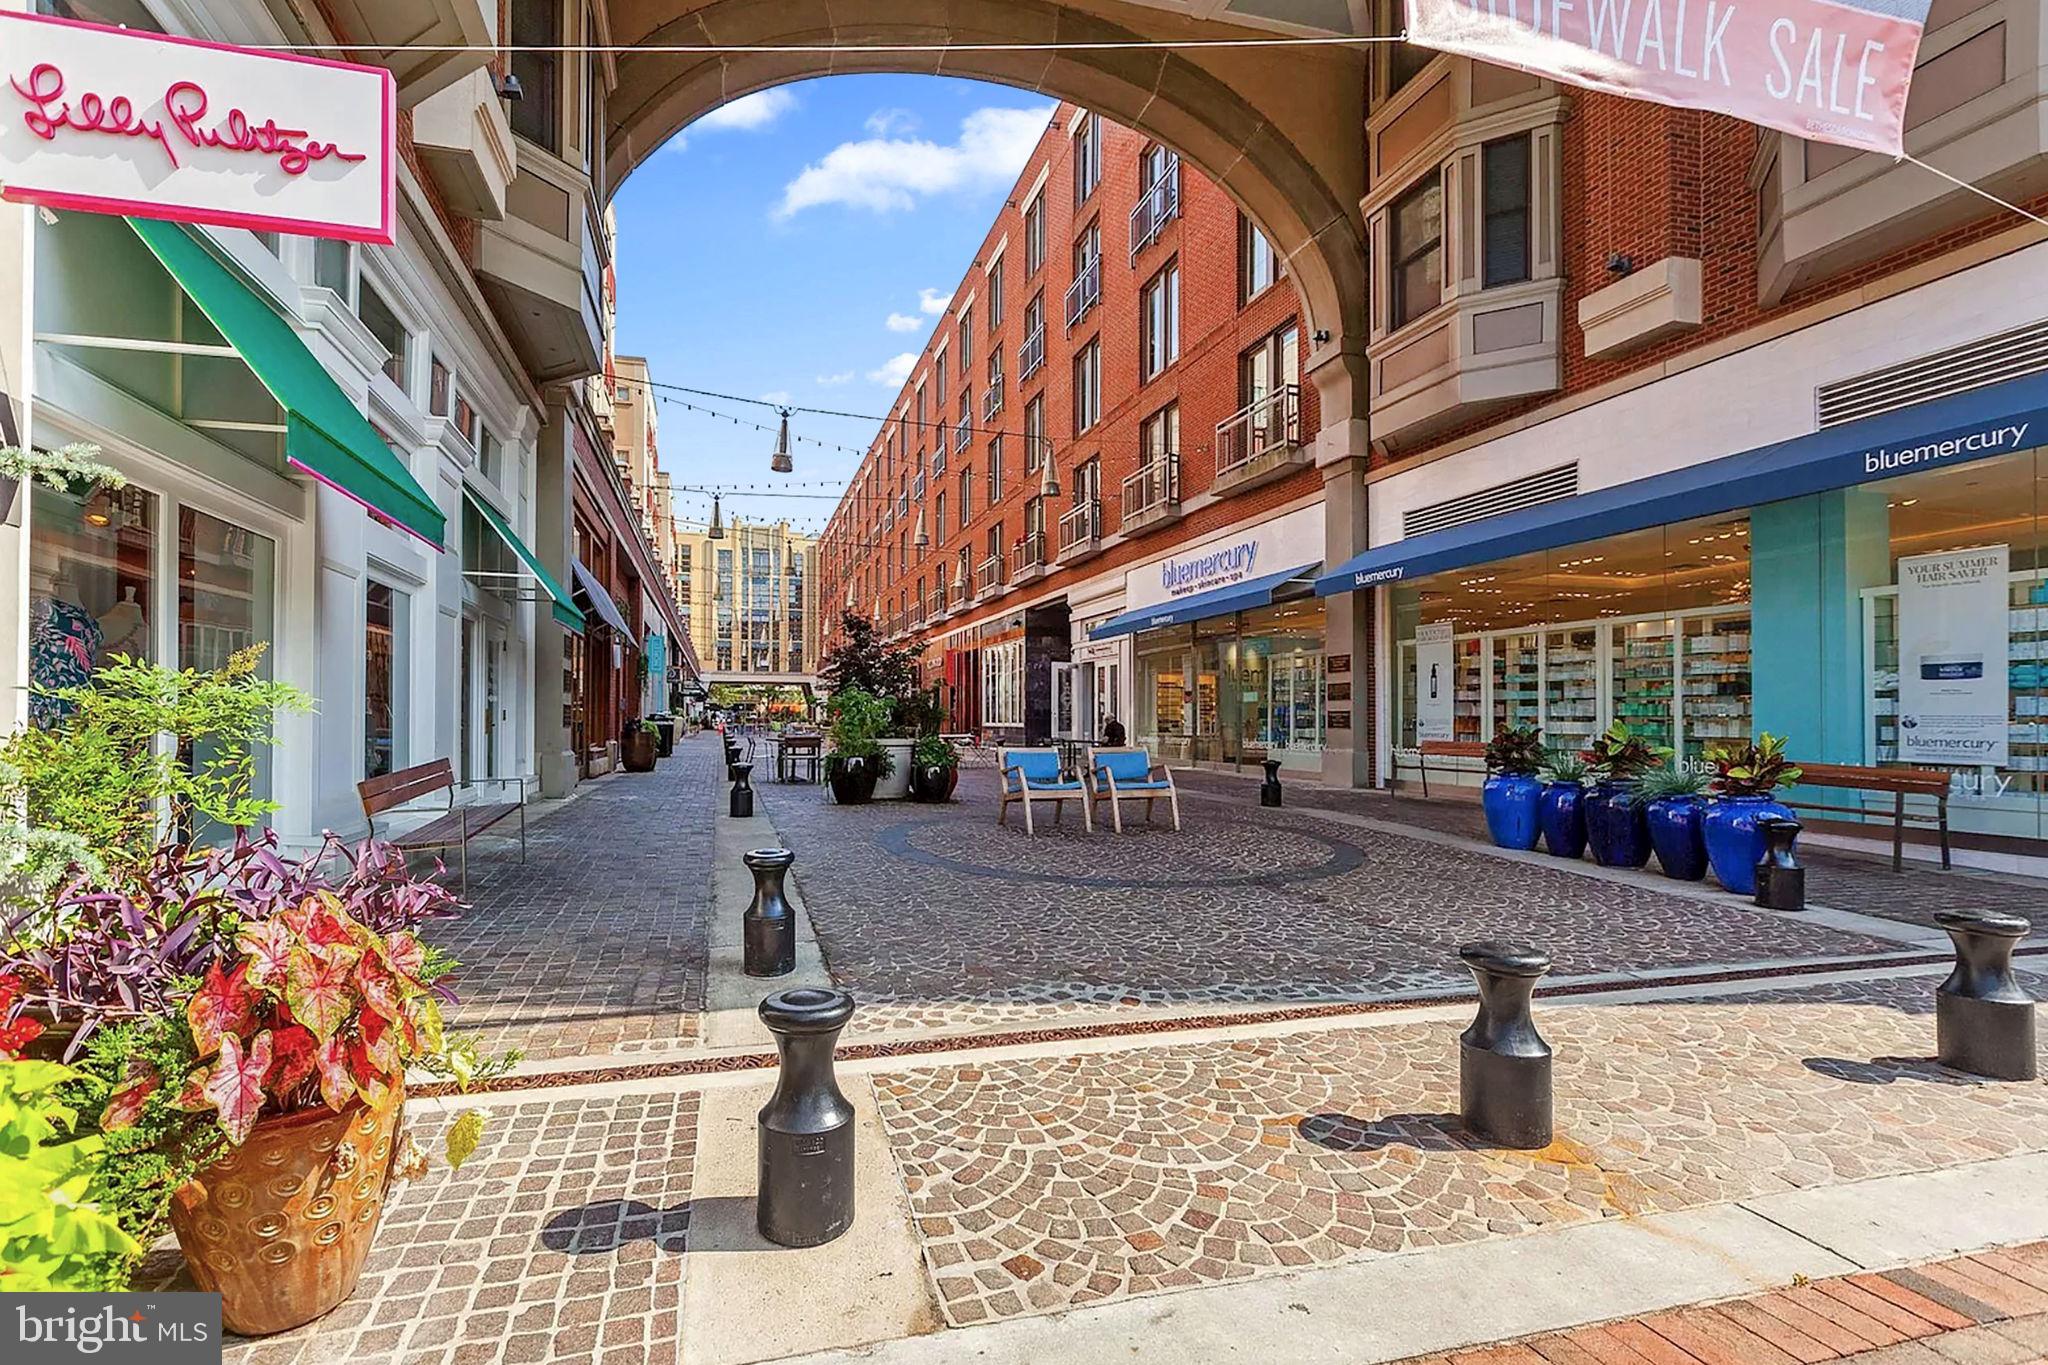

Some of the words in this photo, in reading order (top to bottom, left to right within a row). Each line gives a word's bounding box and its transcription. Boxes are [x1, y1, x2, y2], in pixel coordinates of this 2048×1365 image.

[1765, 18, 1885, 121] SALE
[10, 63, 180, 170] Lilly
[164, 81, 367, 175] Pulitzer
[1865, 422, 2029, 473] bluemercury
[1162, 540, 1258, 590] bluemercury
[1355, 566, 1404, 586] bluemercury
[1907, 563, 1941, 576] YOUR
[1942, 556, 1999, 572] SUMMER
[1917, 571, 1947, 584] HAIR
[1948, 567, 1988, 580] SAVER
[1906, 735, 1998, 752] bluemercury
